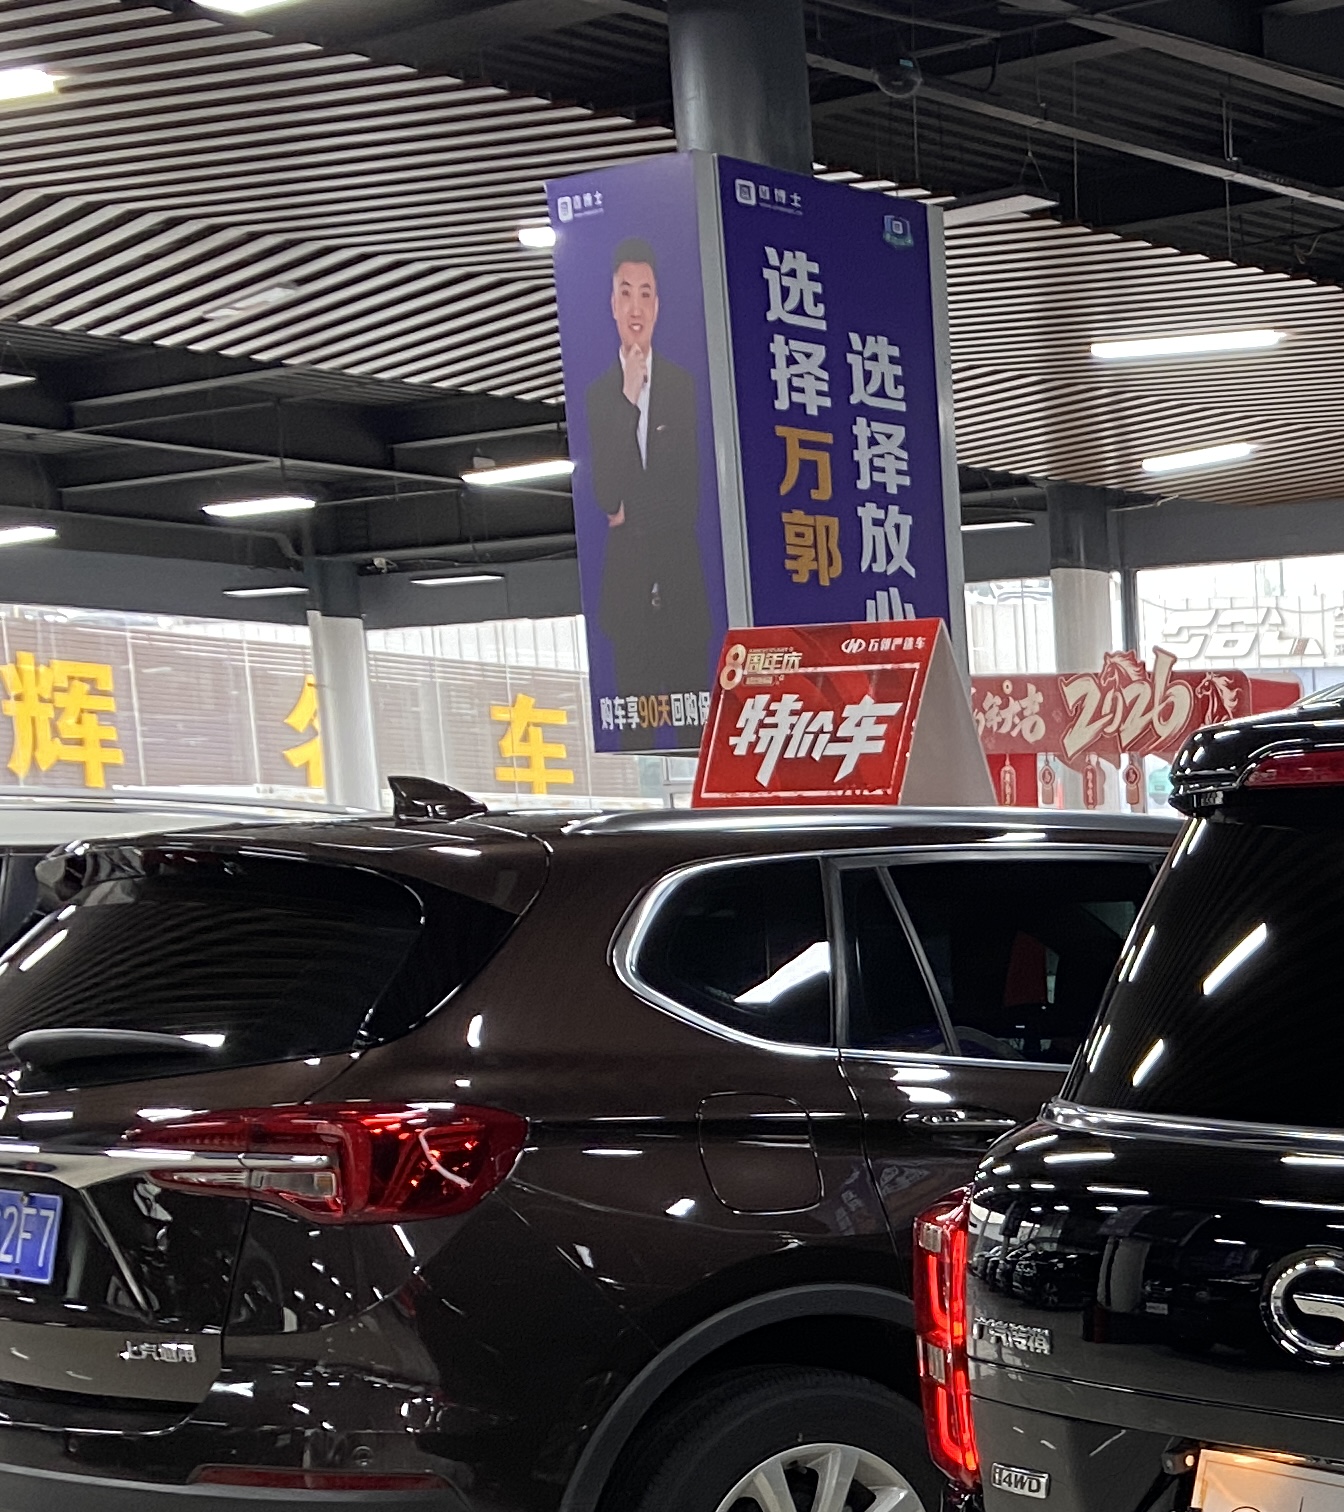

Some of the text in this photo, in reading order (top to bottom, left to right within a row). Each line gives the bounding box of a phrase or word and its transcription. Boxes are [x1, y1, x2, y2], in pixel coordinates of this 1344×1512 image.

[762, 246, 842, 587] 选择万郭
[729, 693, 903, 788] 特价车
